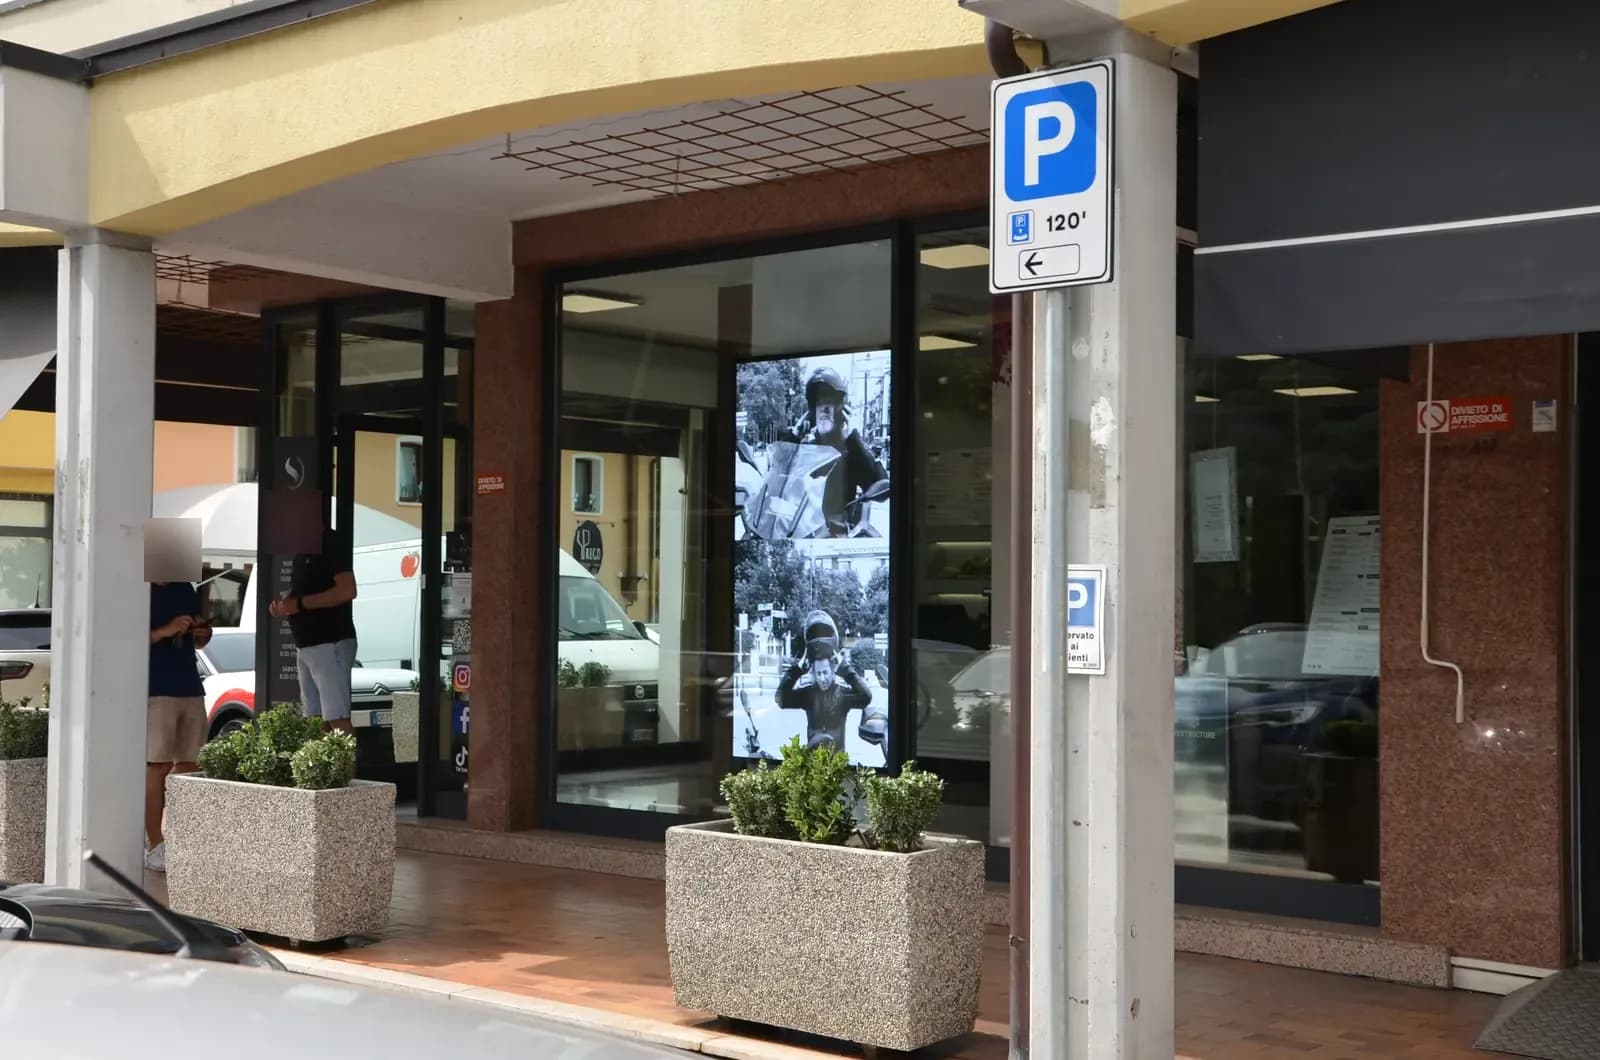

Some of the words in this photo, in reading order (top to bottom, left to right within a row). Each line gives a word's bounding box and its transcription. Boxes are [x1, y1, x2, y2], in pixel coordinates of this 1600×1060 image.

[1024, 101, 1076, 186] P
[1451, 405, 1488, 415] DIVIETO
[1492, 404, 1502, 412] DI
[1451, 413, 1508, 424] AFFISSIONE
[1067, 582, 1088, 622] P
[1067, 632, 1095, 640] ervato
[1068, 653, 1088, 662] ienti
